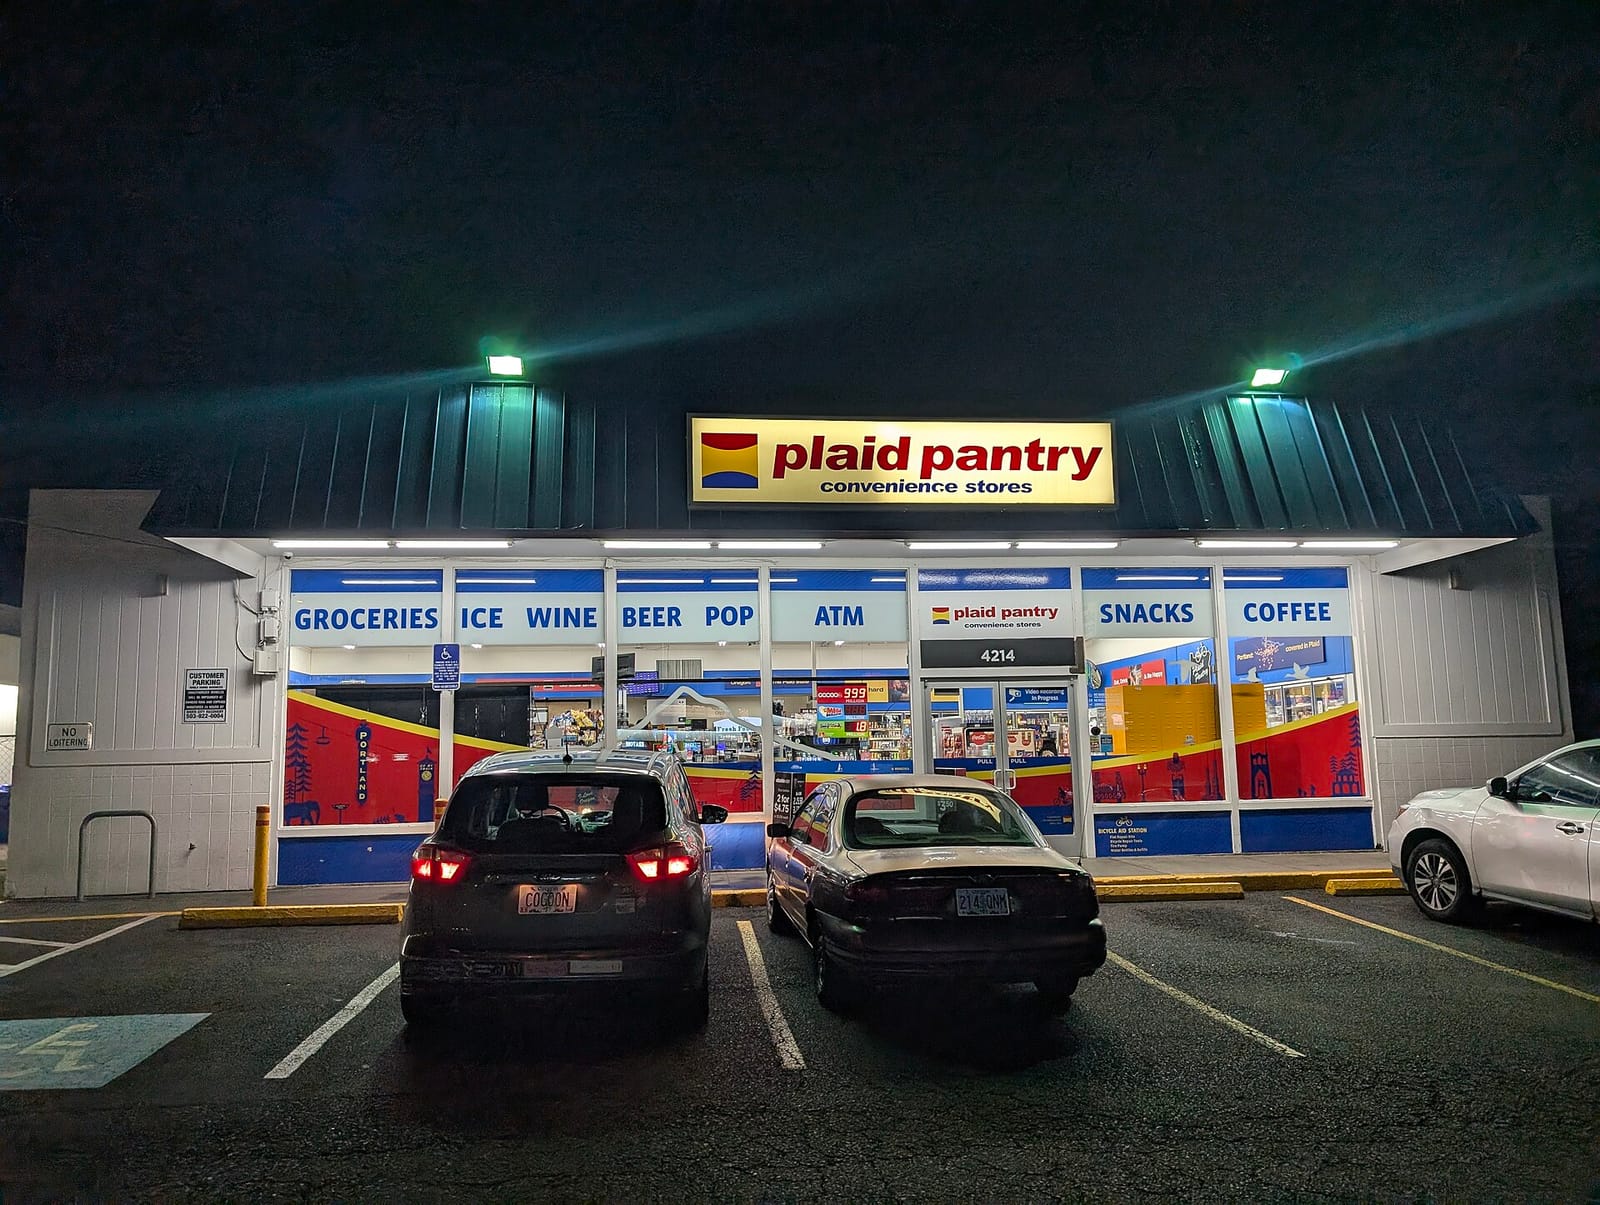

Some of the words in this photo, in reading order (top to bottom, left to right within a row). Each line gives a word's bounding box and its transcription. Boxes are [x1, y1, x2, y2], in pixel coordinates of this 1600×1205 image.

[772, 435, 911, 478] plaid
[920, 438, 1103, 481] pantry
[820, 478, 958, 494] convenience
[965, 479, 1032, 494] stores
[295, 608, 438, 630] GROCERIES
[461, 608, 503, 628] ICE
[527, 608, 597, 628] WINE
[622, 606, 682, 628] BEER
[706, 606, 754, 626] POP
[814, 606, 864, 626] ATM
[954, 606, 996, 620] plaid
[1001, 606, 1058, 620] pantry
[1100, 604, 1194, 624] SNACKS
[1243, 602, 1332, 622] COFFEE
[980, 649, 1016, 662] 4214
[844, 688, 866, 698] 999
[50, 738, 87, 746] LOITERING
[62, 728, 76, 736] NO
[359, 732, 368, 800] PORTLAND
[960, 895, 980, 910] 214
